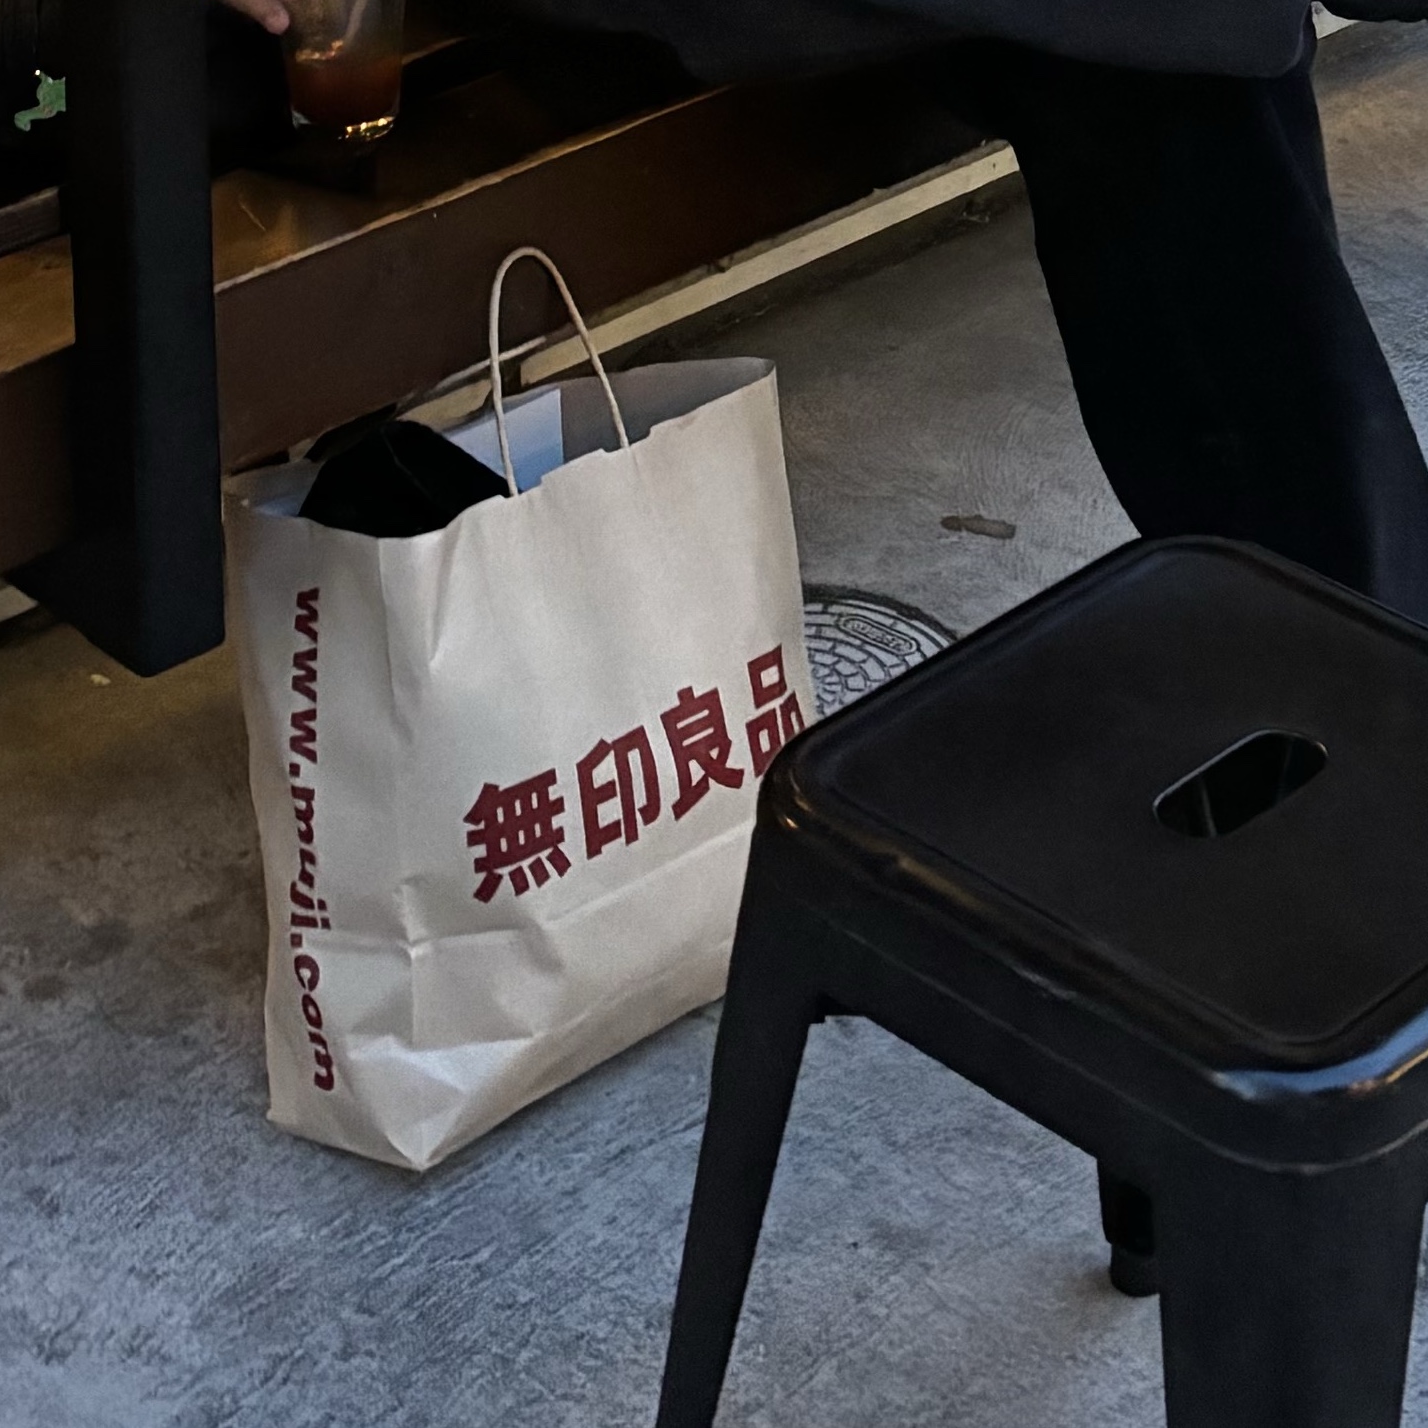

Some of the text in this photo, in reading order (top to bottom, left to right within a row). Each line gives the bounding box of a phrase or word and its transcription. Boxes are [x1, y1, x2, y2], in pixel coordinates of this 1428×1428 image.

[288, 587, 335, 1092] www.muji.com
[462, 643, 806, 903] 無印良品
